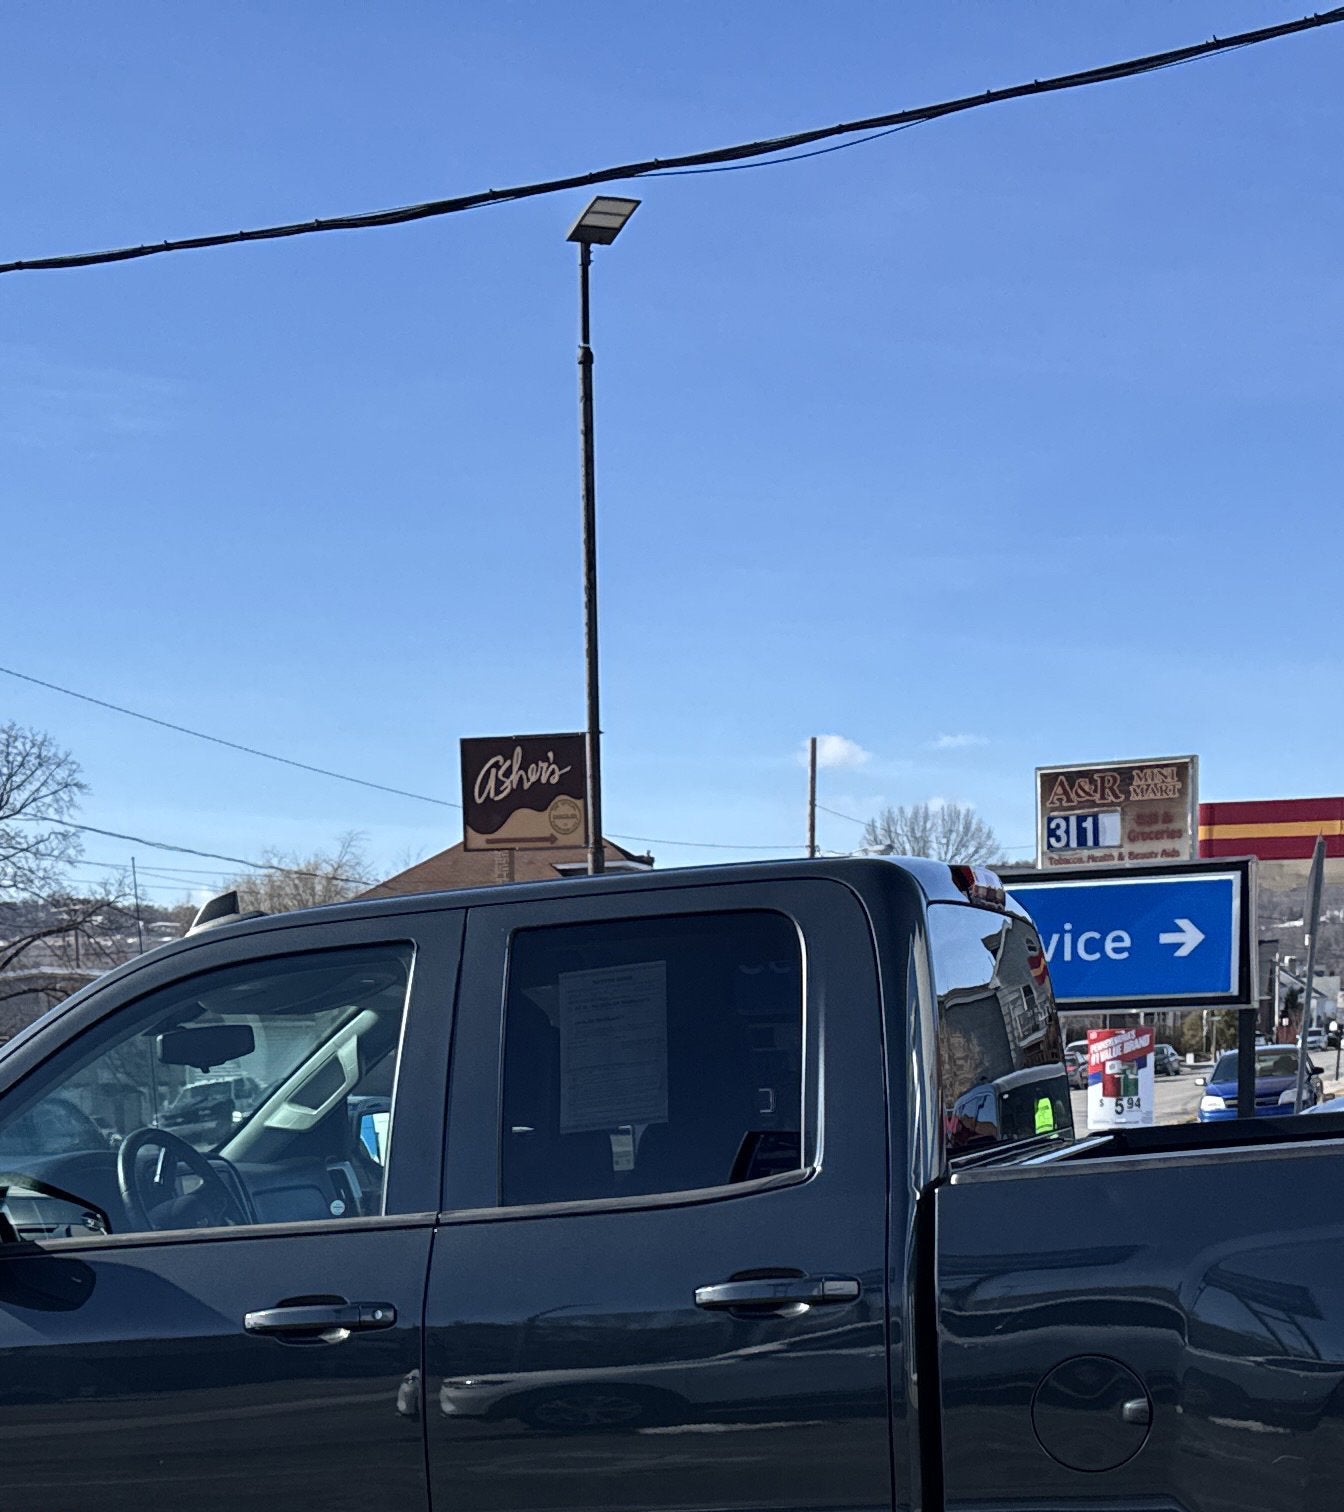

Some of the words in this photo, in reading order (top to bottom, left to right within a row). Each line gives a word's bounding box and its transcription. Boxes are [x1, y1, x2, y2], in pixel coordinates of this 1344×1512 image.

[1132, 767, 1178, 785] MINI
[1046, 772, 1125, 807] A&R
[1129, 782, 1182, 801] MART
[1127, 827, 1183, 843] Groceries
[1087, 853, 1116, 863] Health
[1117, 851, 1125, 861] &
[1160, 847, 1181, 858] Aids
[1038, 922, 1131, 962] vice
[1115, 1097, 1124, 1115] 5
[1127, 1097, 1141, 1109] 94
